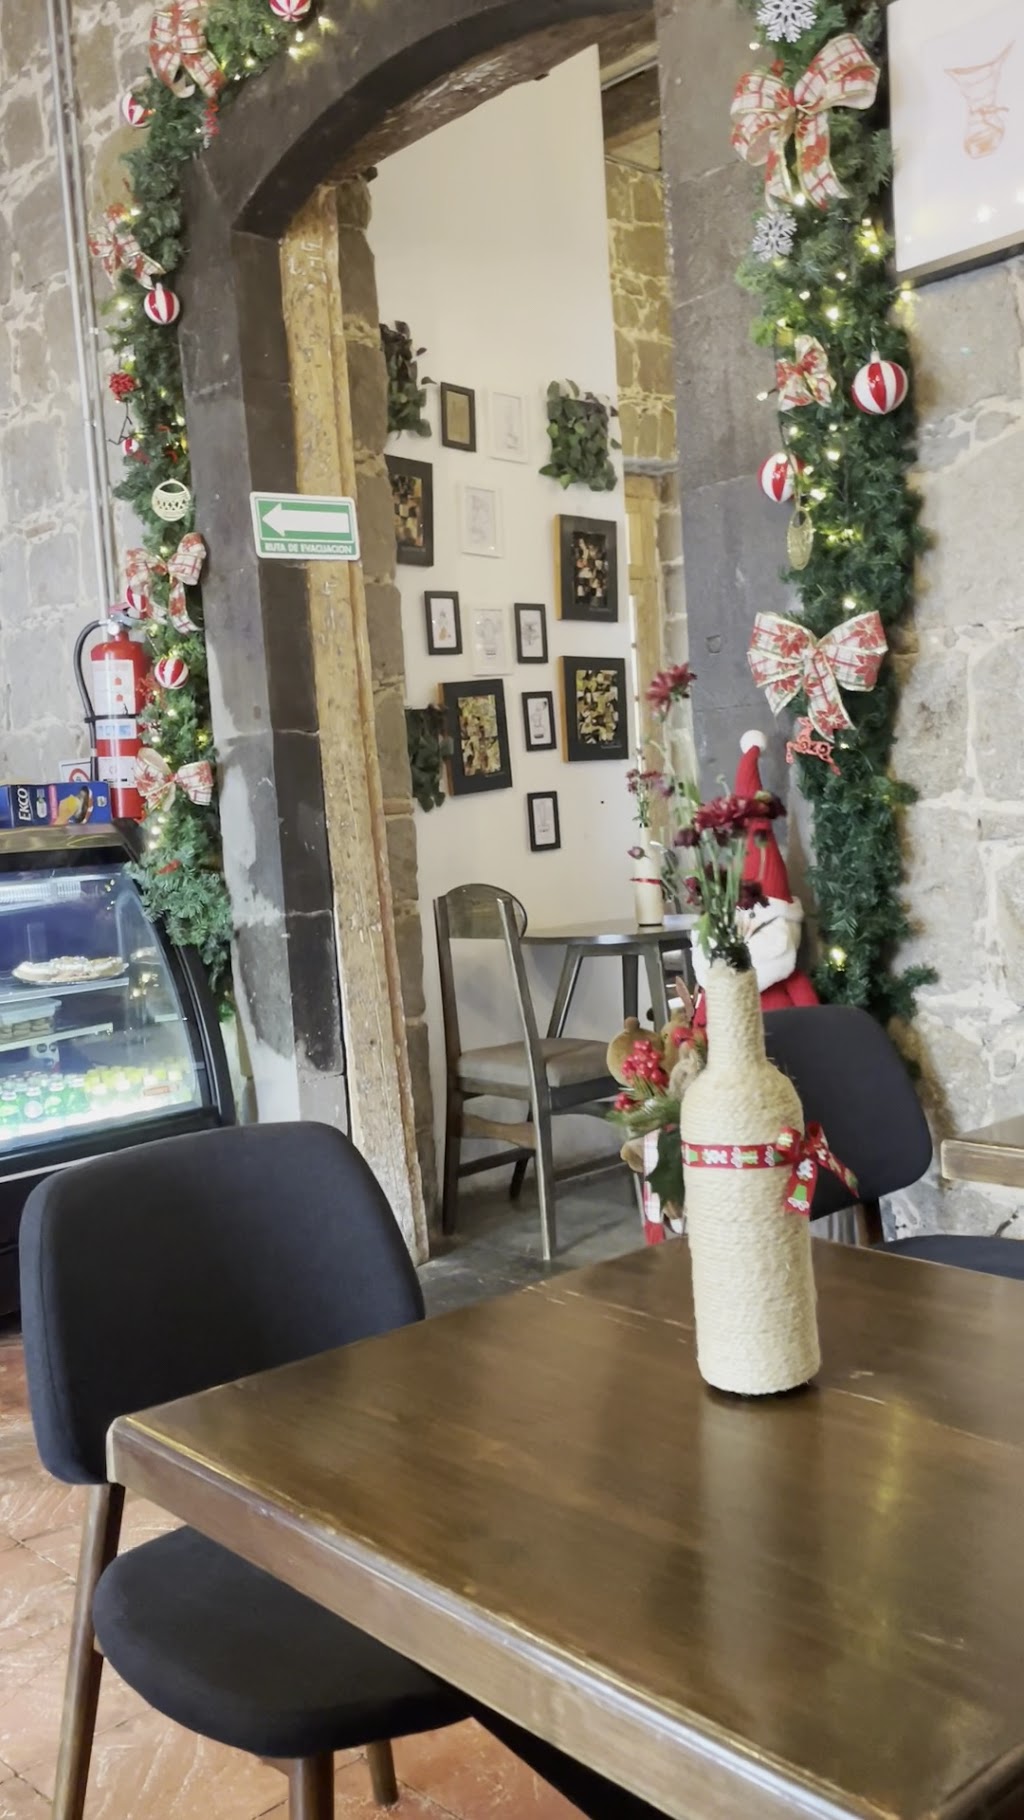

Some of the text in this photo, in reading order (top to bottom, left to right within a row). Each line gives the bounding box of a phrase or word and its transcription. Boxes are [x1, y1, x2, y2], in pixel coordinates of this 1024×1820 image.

[265, 542, 287, 552] RUTA
[288, 543, 299, 553] DE
[18, 788, 32, 822] EKCO
